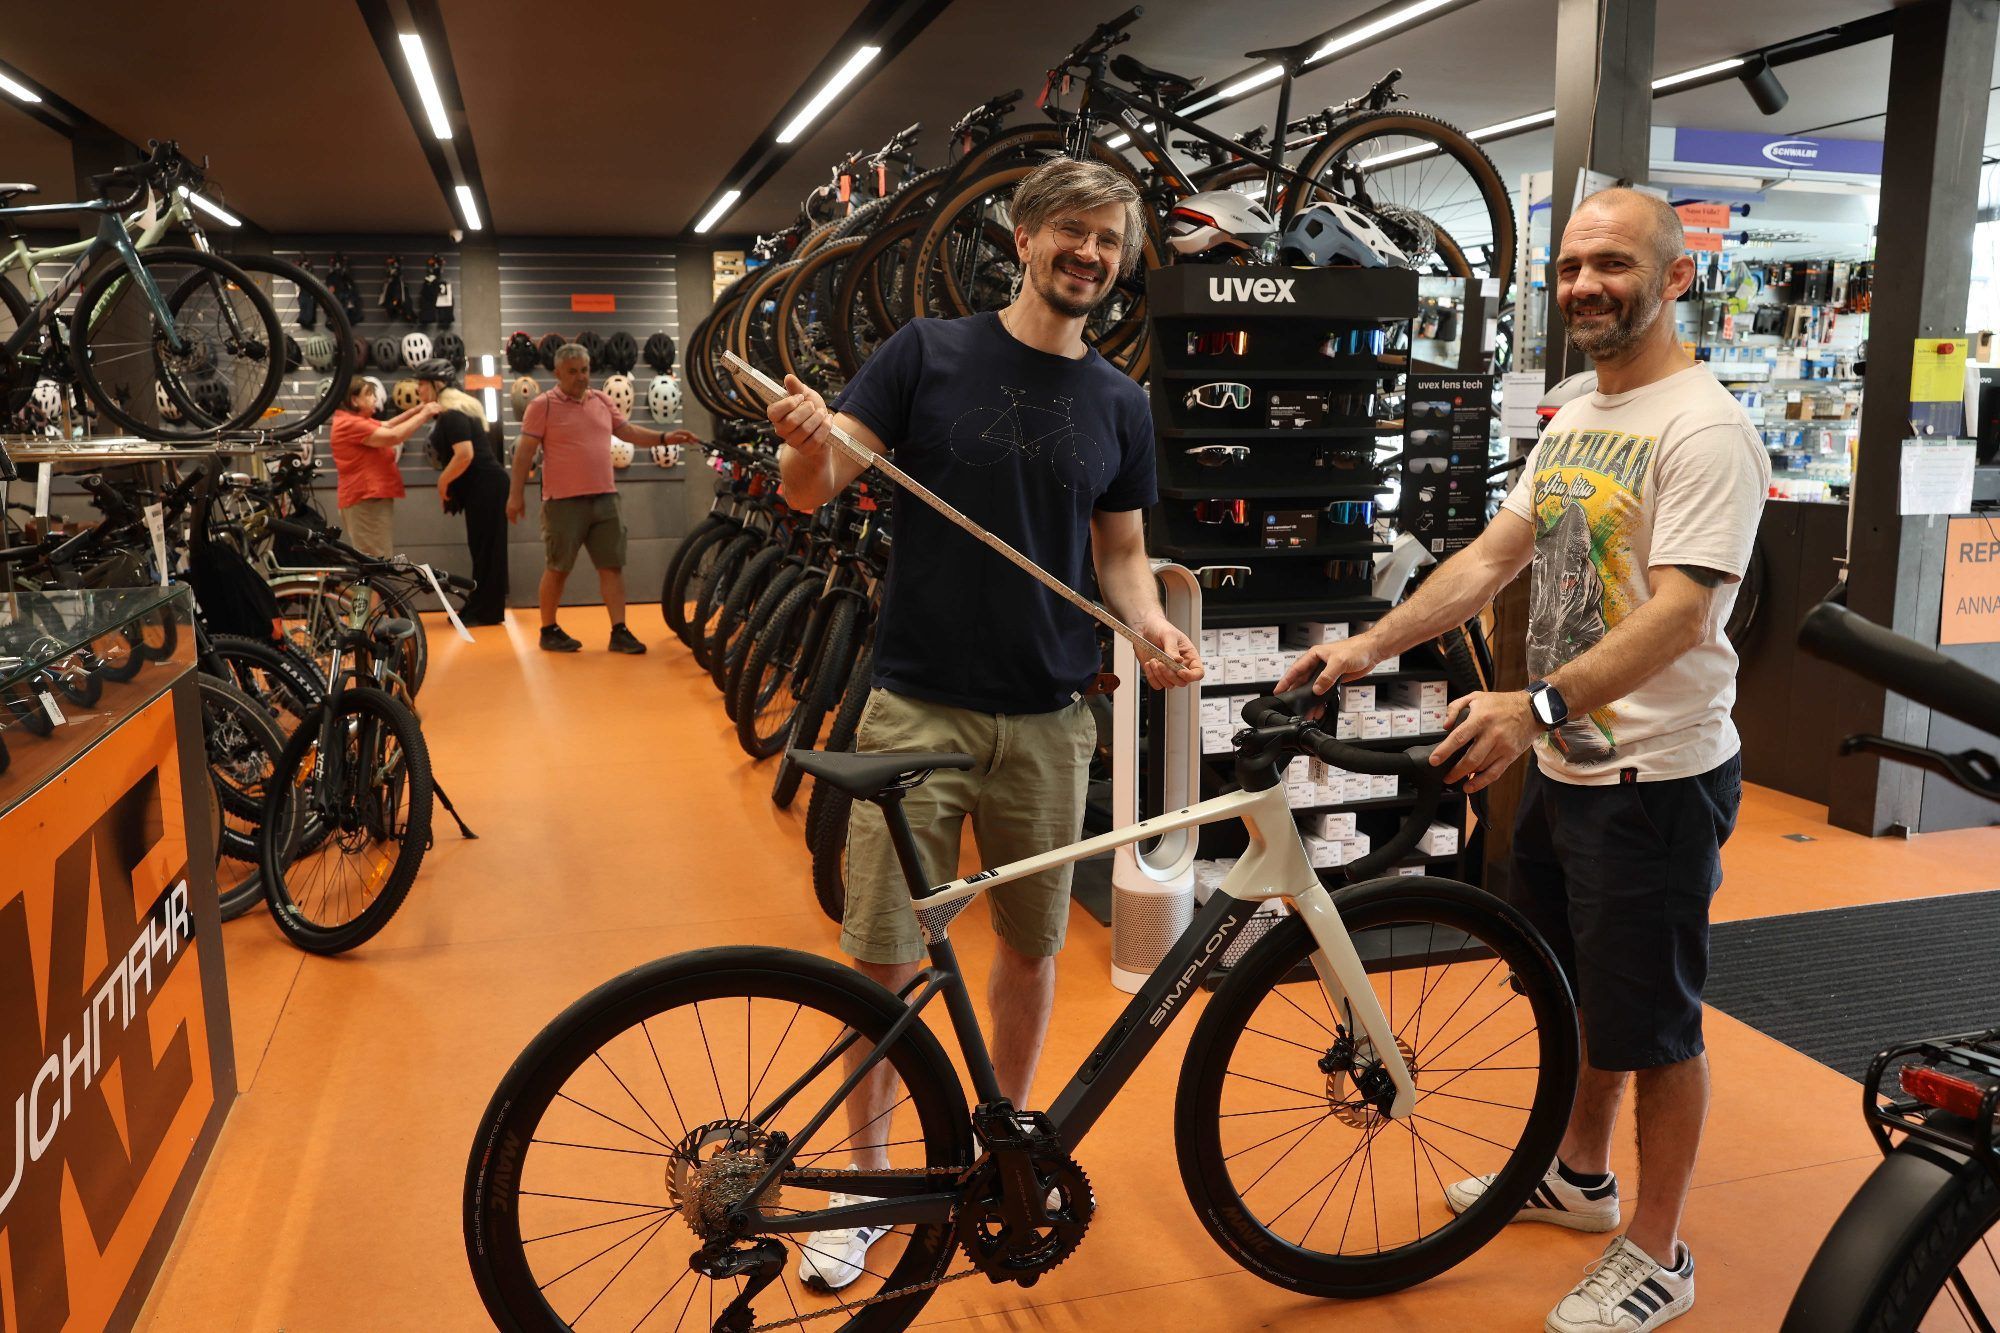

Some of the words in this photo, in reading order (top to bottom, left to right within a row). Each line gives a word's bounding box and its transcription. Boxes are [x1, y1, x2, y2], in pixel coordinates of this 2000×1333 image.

[1772, 147, 1818, 158] SCHWALBE
[1209, 277, 1297, 303] uvex
[1418, 382, 1440, 390] uvex
[1441, 380, 1461, 389] lens
[1462, 380, 1483, 389] tech
[281, 661, 321, 703] MAXXIS
[275, 901, 300, 930] KENDA
[1149, 914, 1238, 1028] SIMPLON
